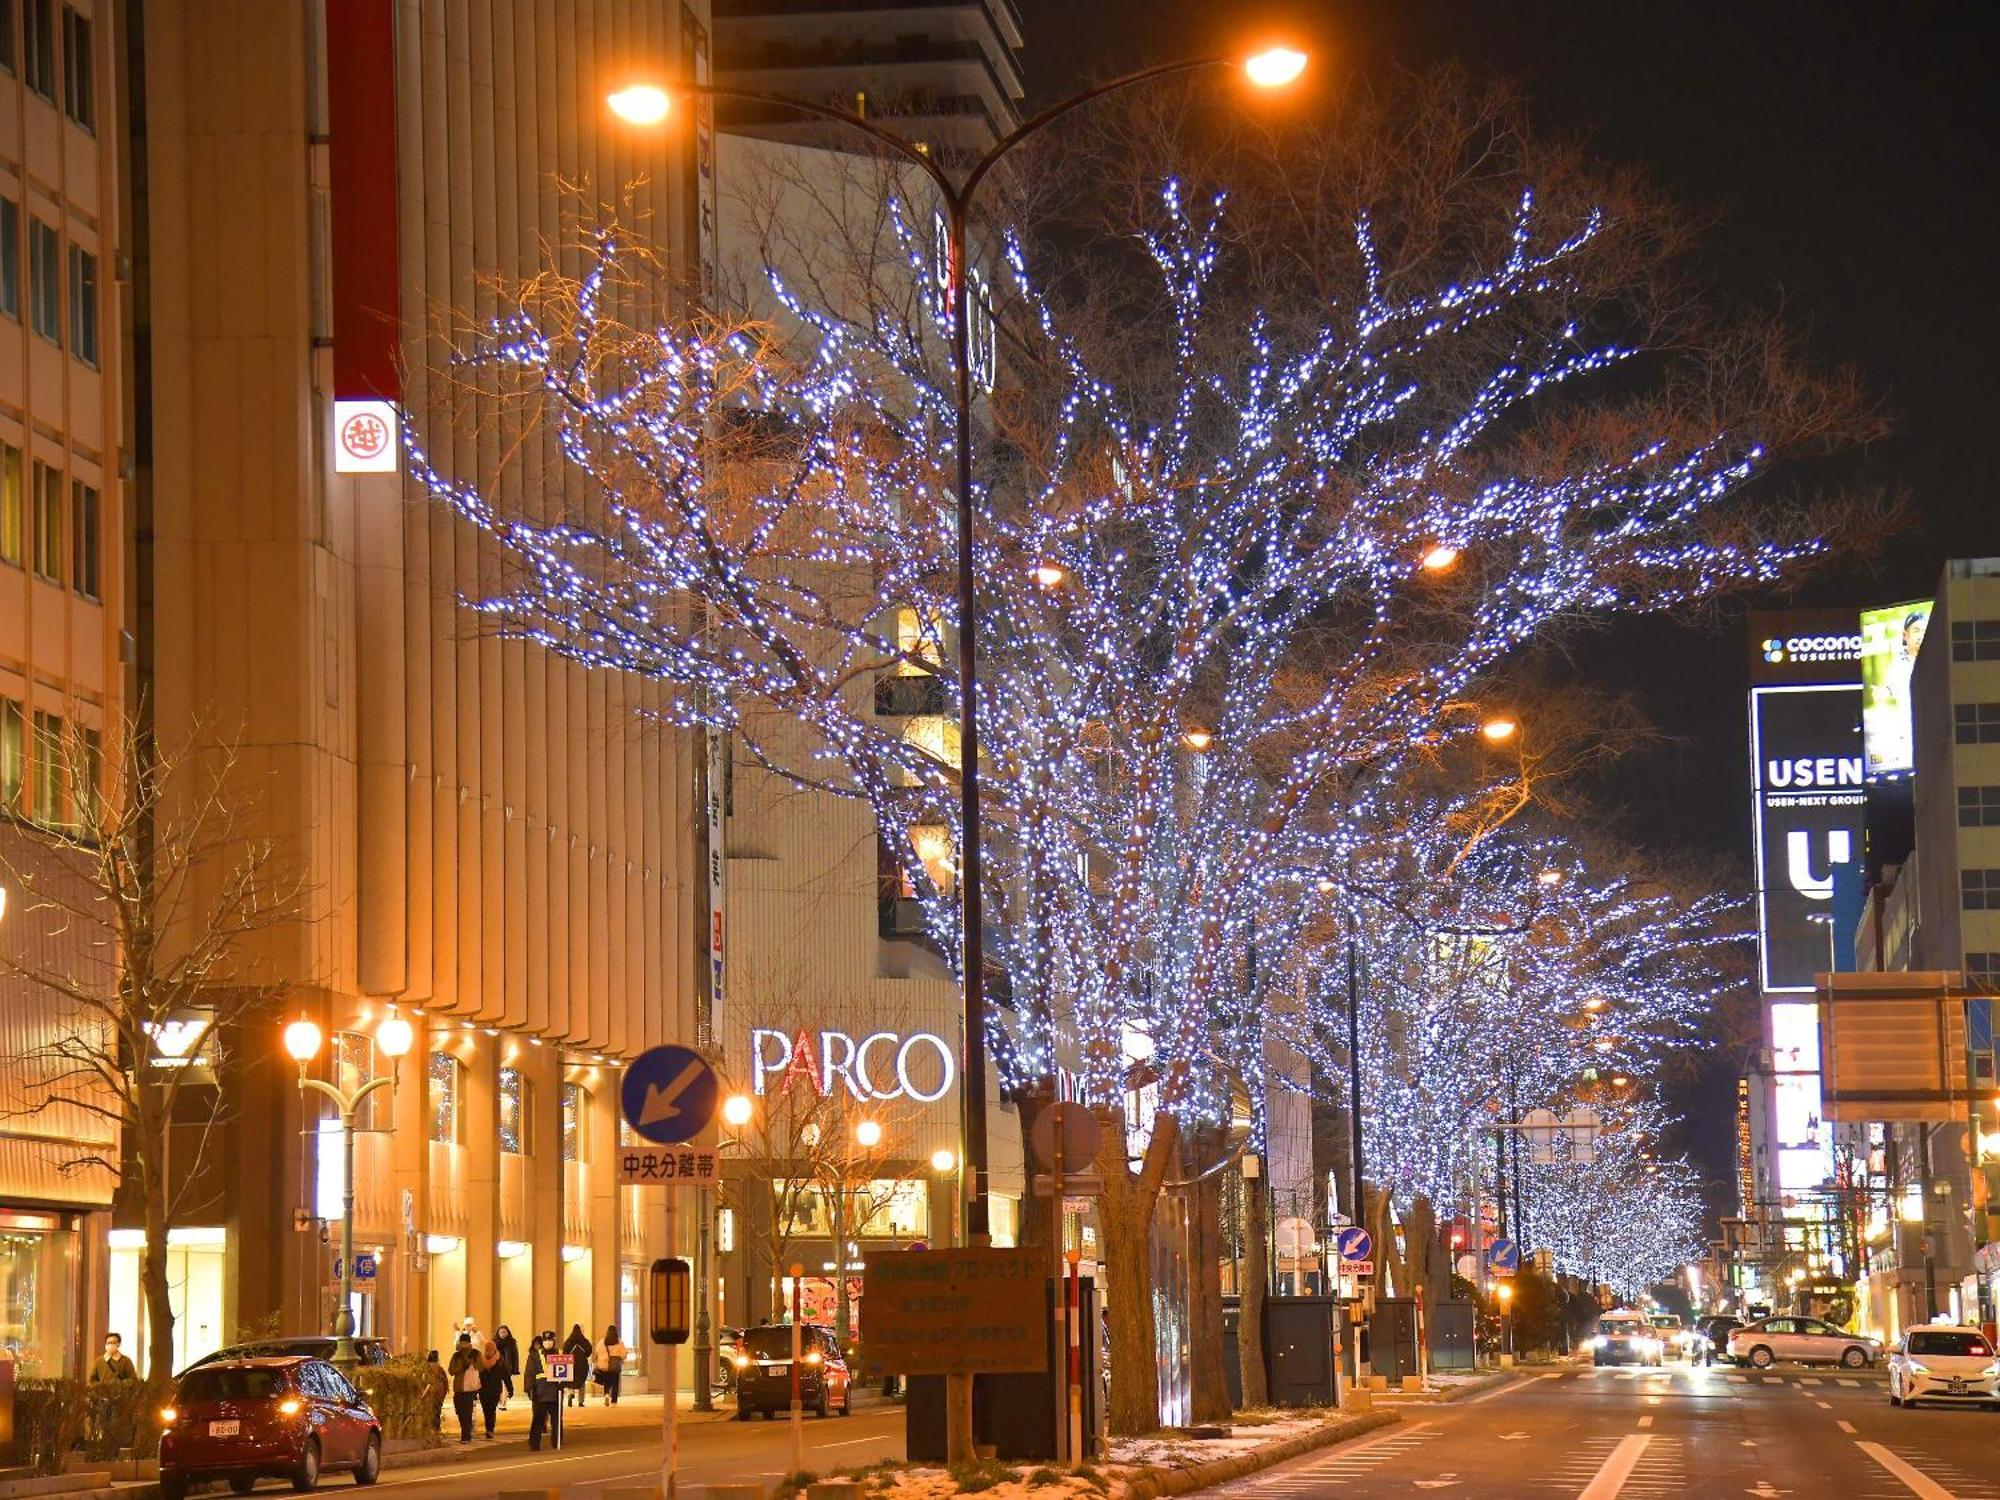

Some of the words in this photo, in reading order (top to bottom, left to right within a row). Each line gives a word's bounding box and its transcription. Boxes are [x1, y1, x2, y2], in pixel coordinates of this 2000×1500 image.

[1768, 758, 1863, 787] USEN
[1767, 797, 1827, 807] USEN-NEXT
[752, 1028, 954, 1102] PARCO
[623, 1153, 714, 1179] 中央分離帯
[555, 1364, 566, 1377] P
